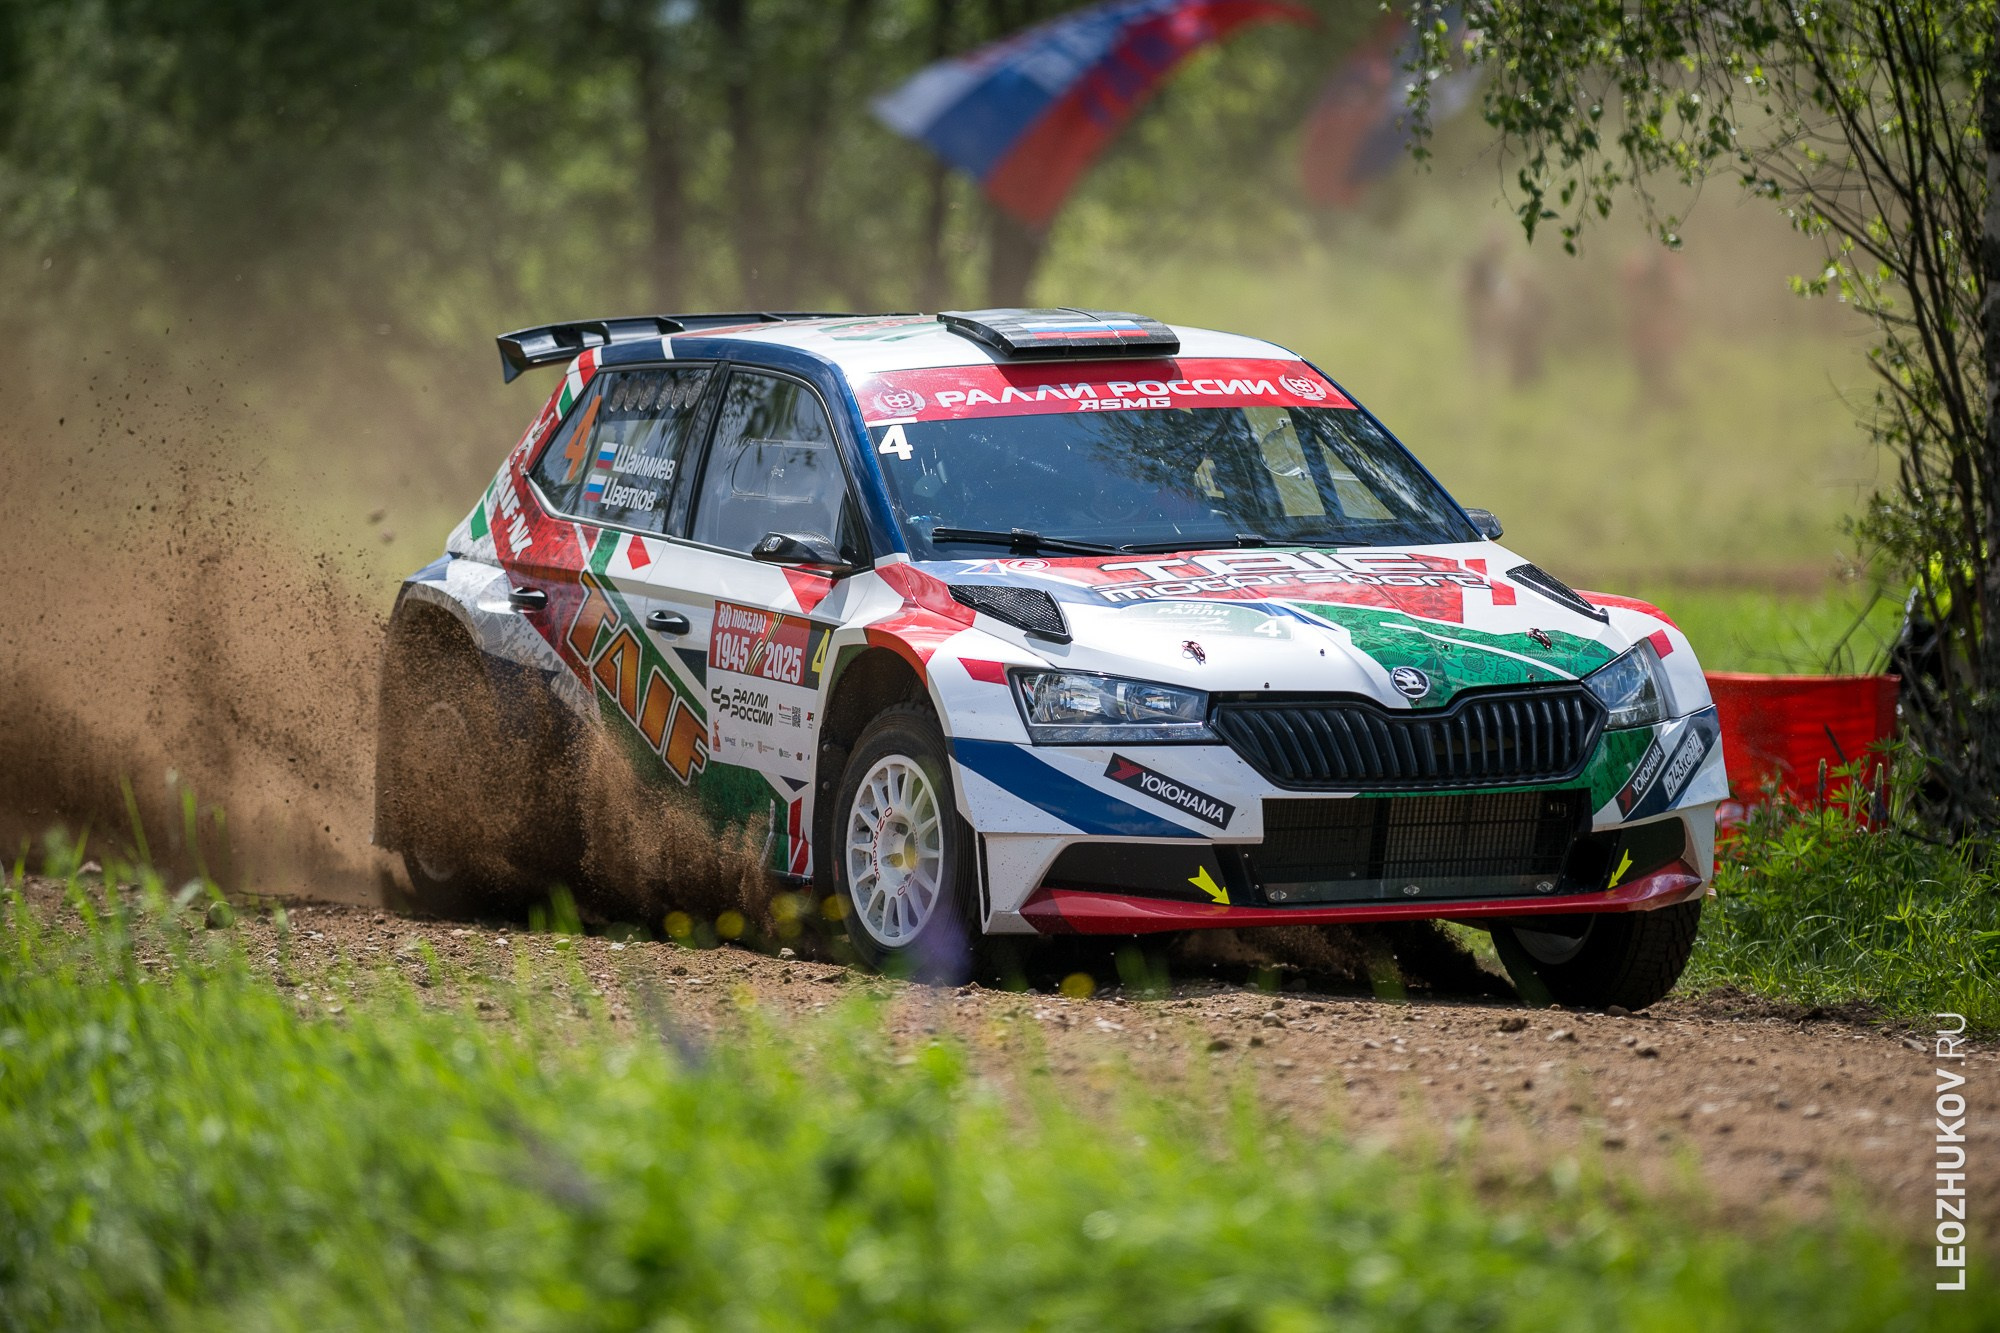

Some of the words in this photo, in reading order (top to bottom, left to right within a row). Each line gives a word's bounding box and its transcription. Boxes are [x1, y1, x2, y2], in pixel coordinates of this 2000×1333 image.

[935, 382, 1097, 408] РАЛЛИ
[1107, 378, 1279, 398] РОССИИ
[564, 395, 602, 481] 4
[878, 424, 914, 461] 4
[613, 443, 676, 482] Шаймиев
[600, 476, 656, 513] Цветков
[1097, 551, 1433, 583] TAIF
[1098, 571, 1495, 603] motorsport
[717, 603, 733, 629] 80
[731, 608, 767, 634] ПОБЕДА!
[1157, 607, 1231, 617] РАЛЛИ
[1254, 619, 1282, 638] 4
[714, 632, 751, 672] 1945
[762, 641, 803, 684] 2025
[811, 628, 831, 686] 4
[730, 704, 773, 727] РОССИИ
[732, 688, 769, 709] РАЛЛИ
[1687, 734, 1699, 752] 977
[1631, 744, 1664, 796] YOKOHAMA
[1140, 772, 1225, 823] YOKOHAMA
[872, 831, 881, 882] RACING
